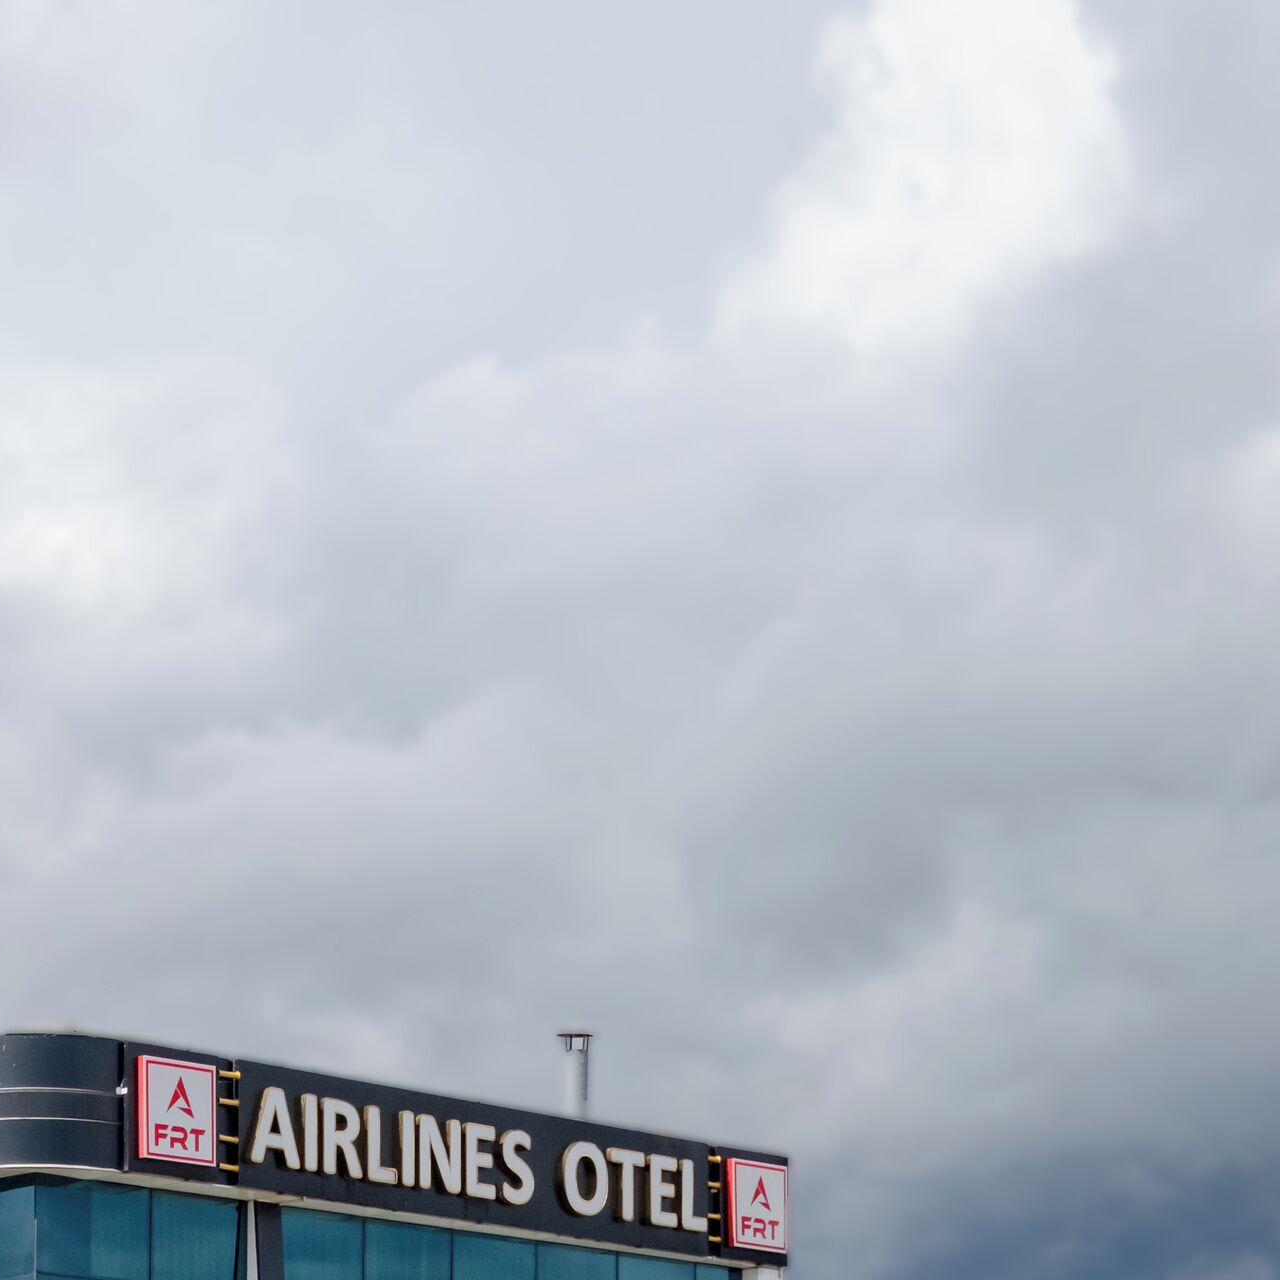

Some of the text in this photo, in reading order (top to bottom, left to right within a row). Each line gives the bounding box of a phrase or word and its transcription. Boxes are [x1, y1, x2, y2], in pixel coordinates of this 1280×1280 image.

[153, 1123, 208, 1154] FRT
[250, 1085, 708, 1232] AIRLINES OTEL
[740, 1216, 779, 1241] FRT
